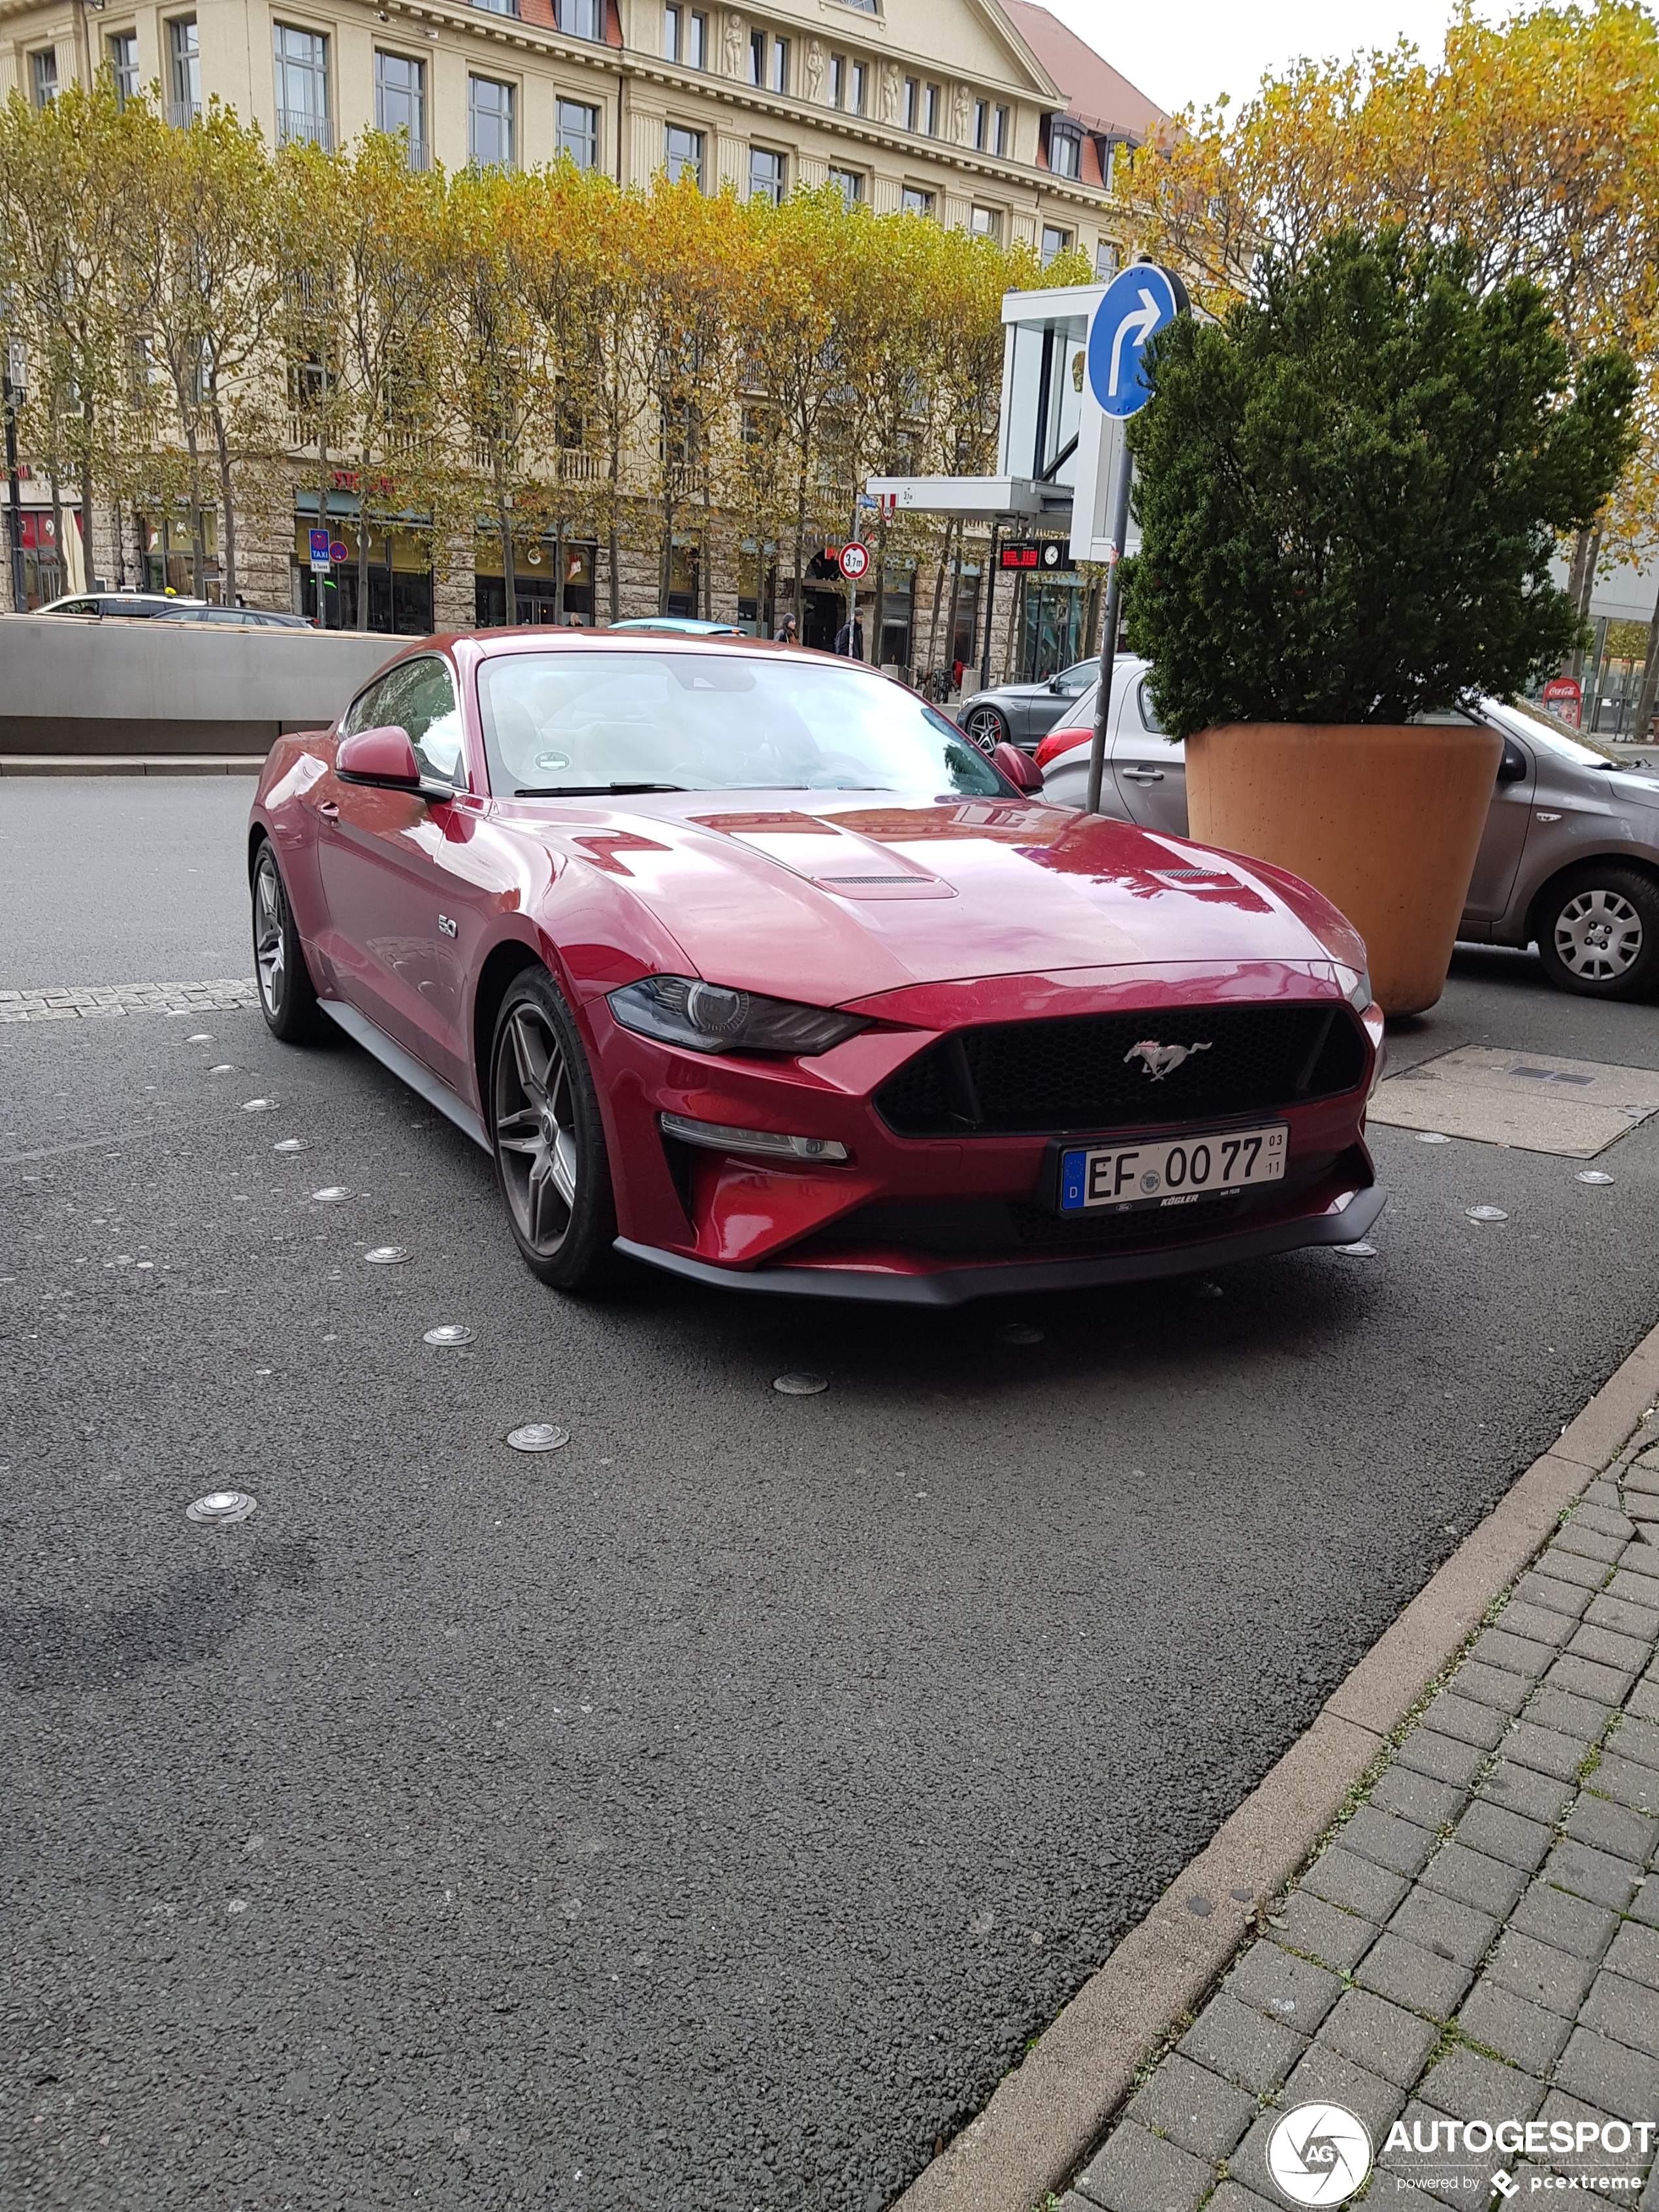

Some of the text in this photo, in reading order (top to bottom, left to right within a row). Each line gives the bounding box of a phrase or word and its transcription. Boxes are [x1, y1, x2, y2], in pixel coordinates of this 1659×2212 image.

[312, 550, 328, 558] TAXI
[438, 914, 457, 938] 5.0
[1269, 1134, 1282, 1146] 03
[1268, 1161, 1279, 1174] 11
[1089, 1152, 1139, 1200] EF
[1069, 1186, 1078, 1199] D
[1160, 1193, 1199, 1207] KÖGLER
